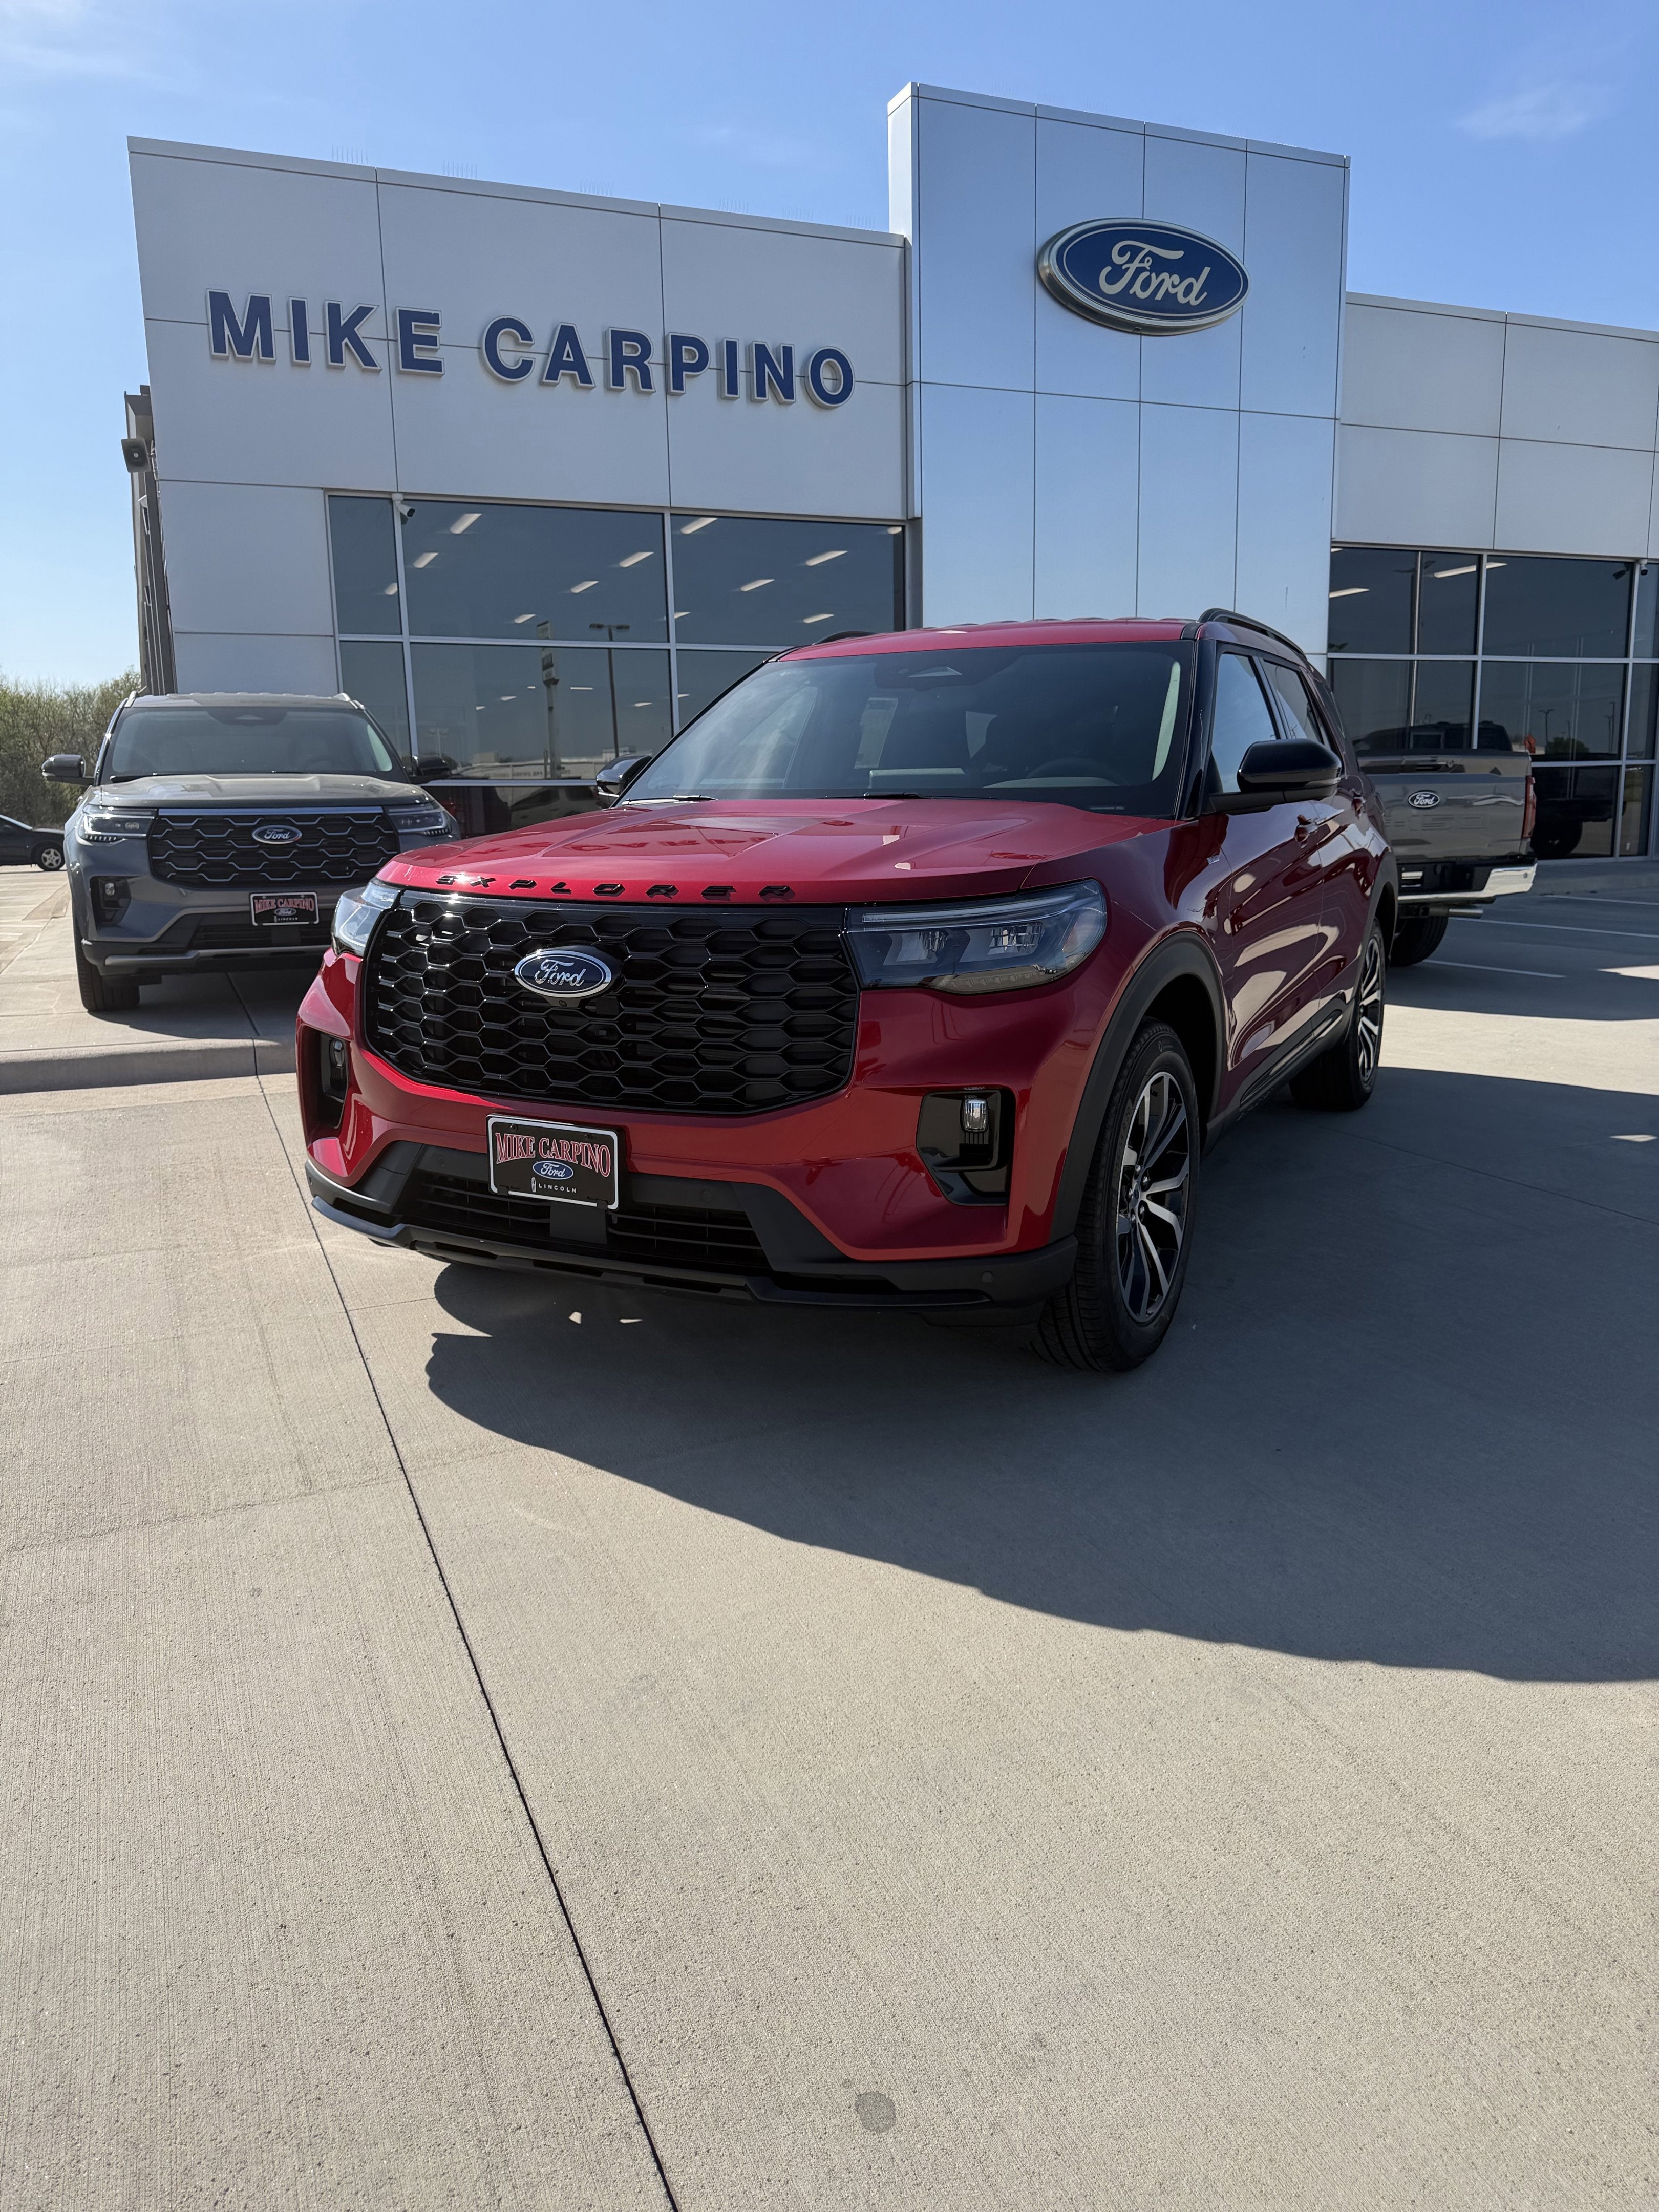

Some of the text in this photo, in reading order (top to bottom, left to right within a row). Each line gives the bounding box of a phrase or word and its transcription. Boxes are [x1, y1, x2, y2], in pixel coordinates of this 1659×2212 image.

[1099, 240, 1211, 306] Ford
[206, 288, 856, 408] MIKE CARPINO
[1414, 794, 1435, 805] Ford
[264, 829, 291, 840] Ford
[435, 874, 792, 900] EXPLORER
[254, 898, 315, 913] MIKE CARPINO
[534, 959, 587, 987] Ford
[495, 1132, 611, 1178] MIKE CARPINO
[540, 1162, 566, 1178] Ford
[539, 1183, 576, 1193] LINCOLN
